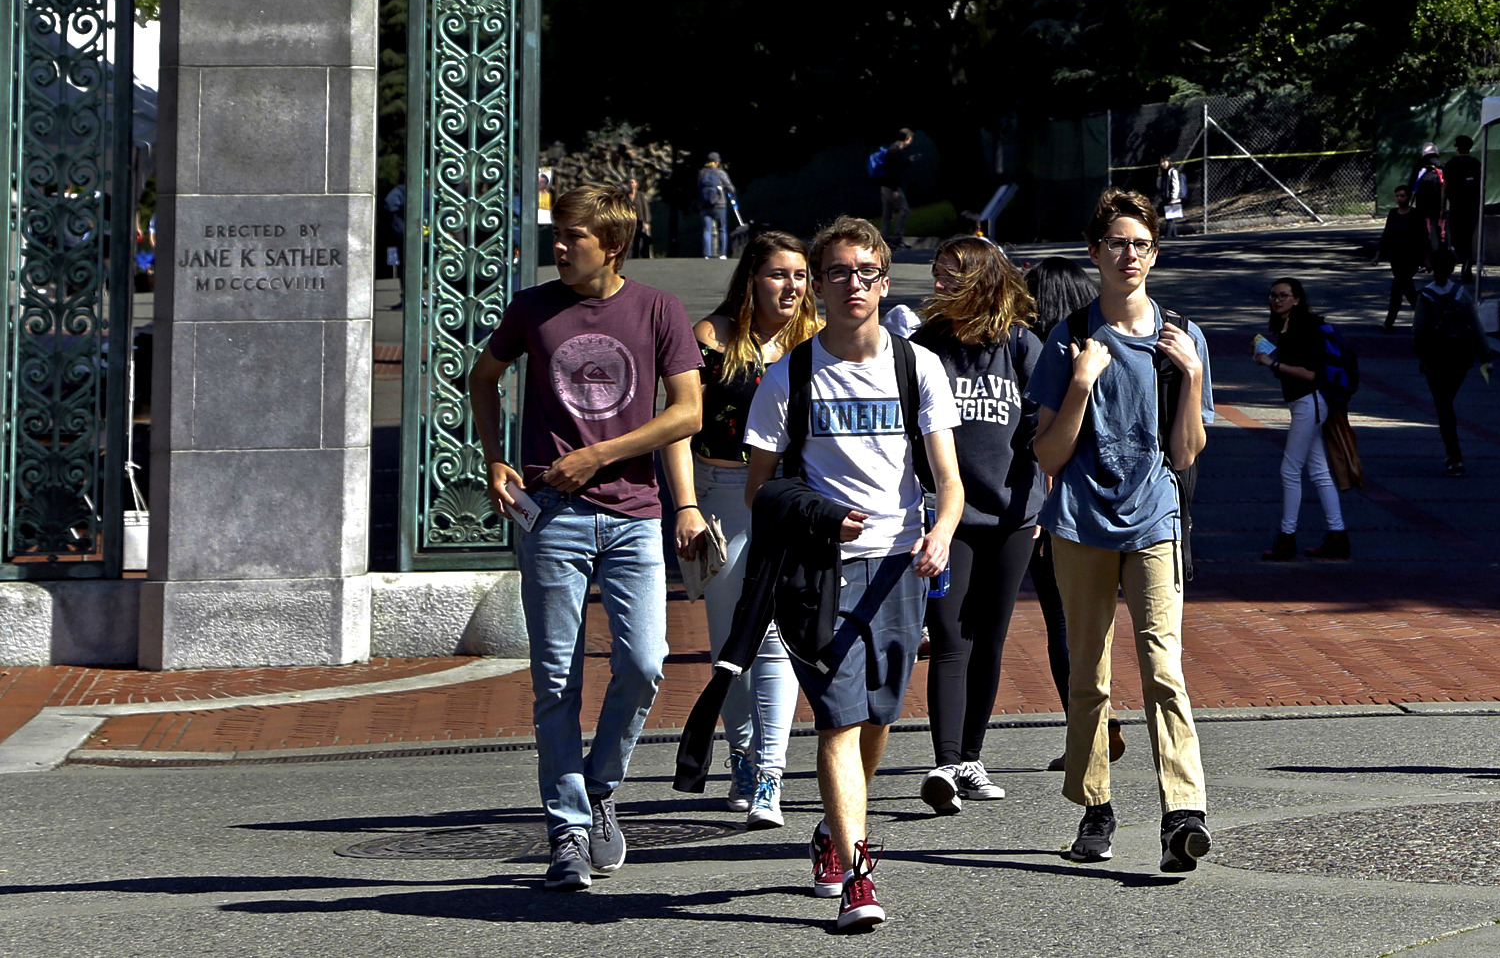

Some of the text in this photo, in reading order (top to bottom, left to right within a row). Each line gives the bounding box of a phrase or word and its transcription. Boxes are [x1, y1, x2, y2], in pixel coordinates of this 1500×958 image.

[204, 223, 322, 239] ERECTED BY
[178, 248, 343, 268] JANE K SATHER
[954, 374, 1022, 410] DAVIS
[817, 403, 903, 431] O'NEILL
